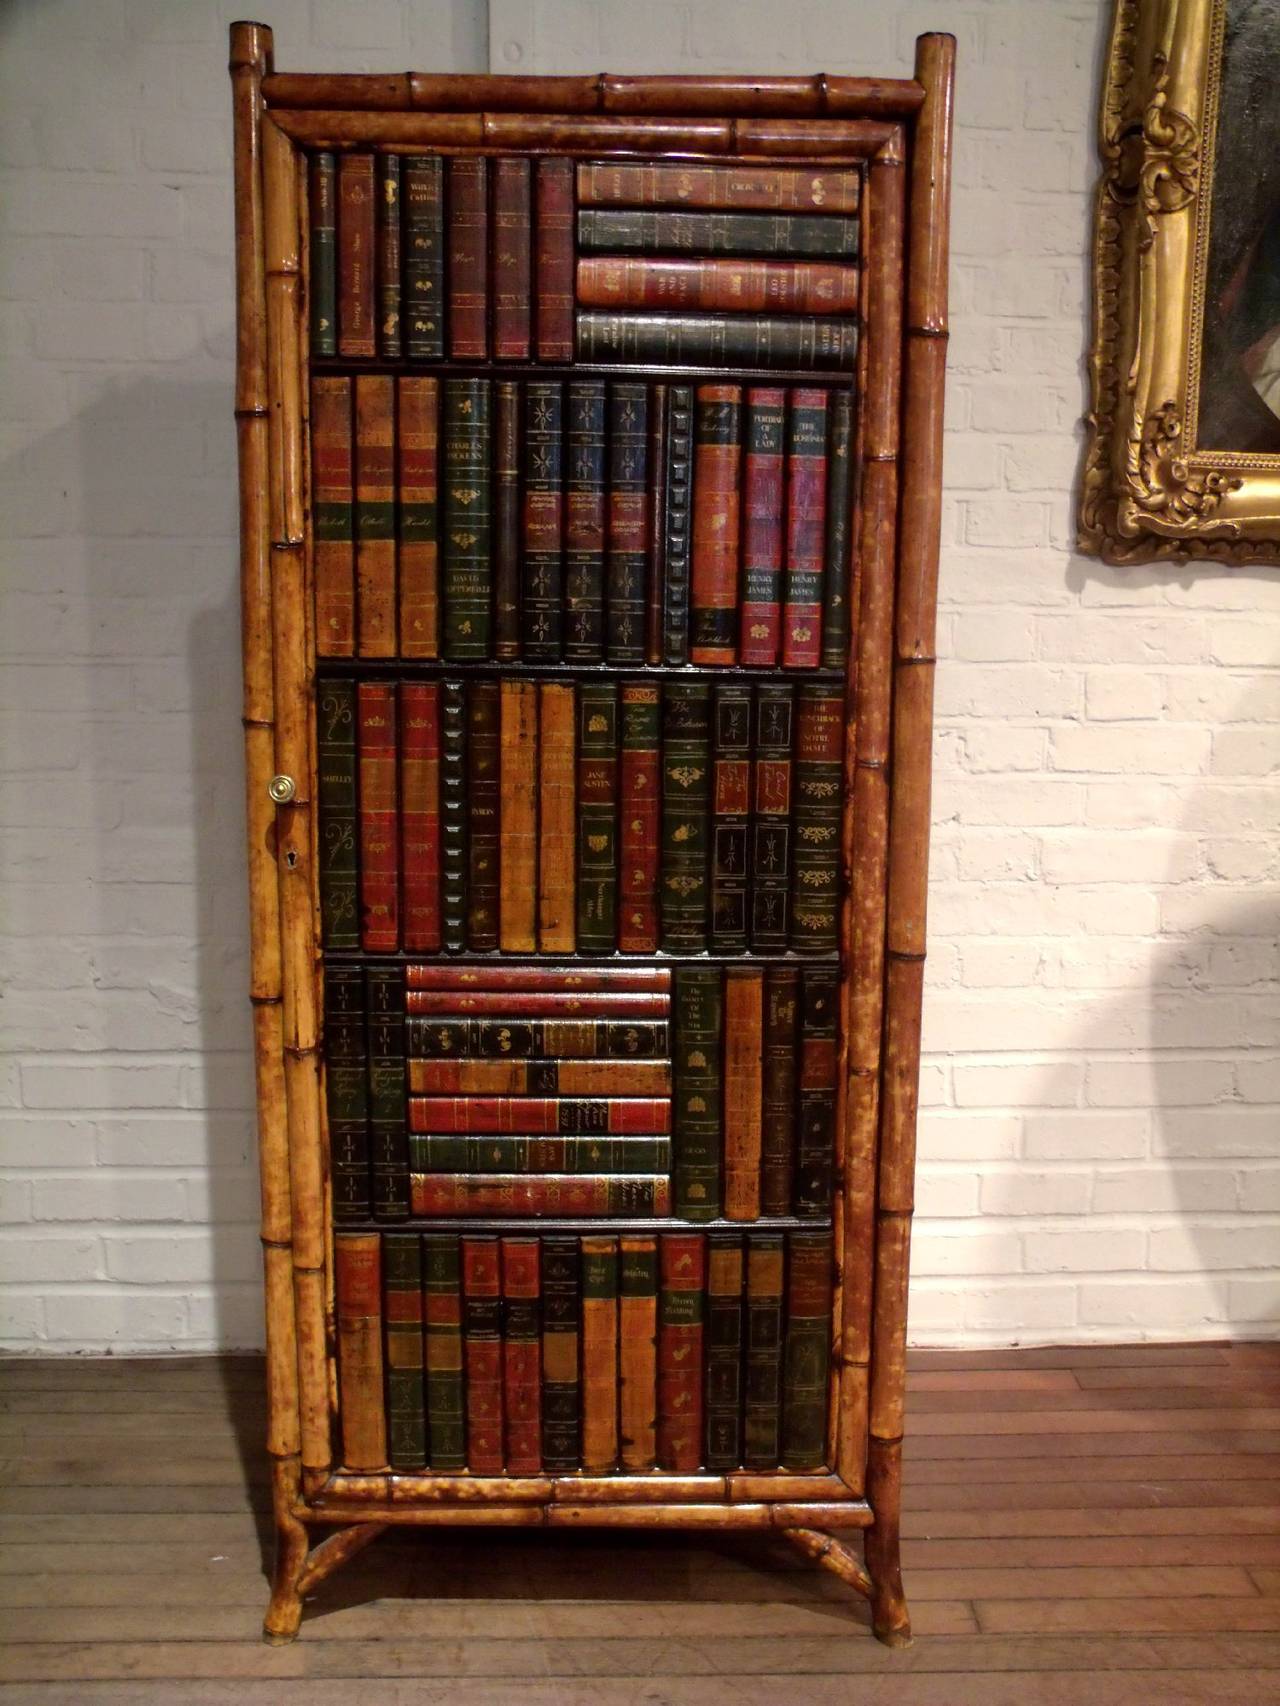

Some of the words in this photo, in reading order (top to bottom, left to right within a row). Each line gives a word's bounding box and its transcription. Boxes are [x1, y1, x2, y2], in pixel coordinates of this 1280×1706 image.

[755, 440, 776, 448] LADY
[747, 575, 773, 584] HENRY
[791, 575, 817, 584] HENRY
[747, 586, 773, 595] JAMES
[790, 587, 815, 596] JAMES
